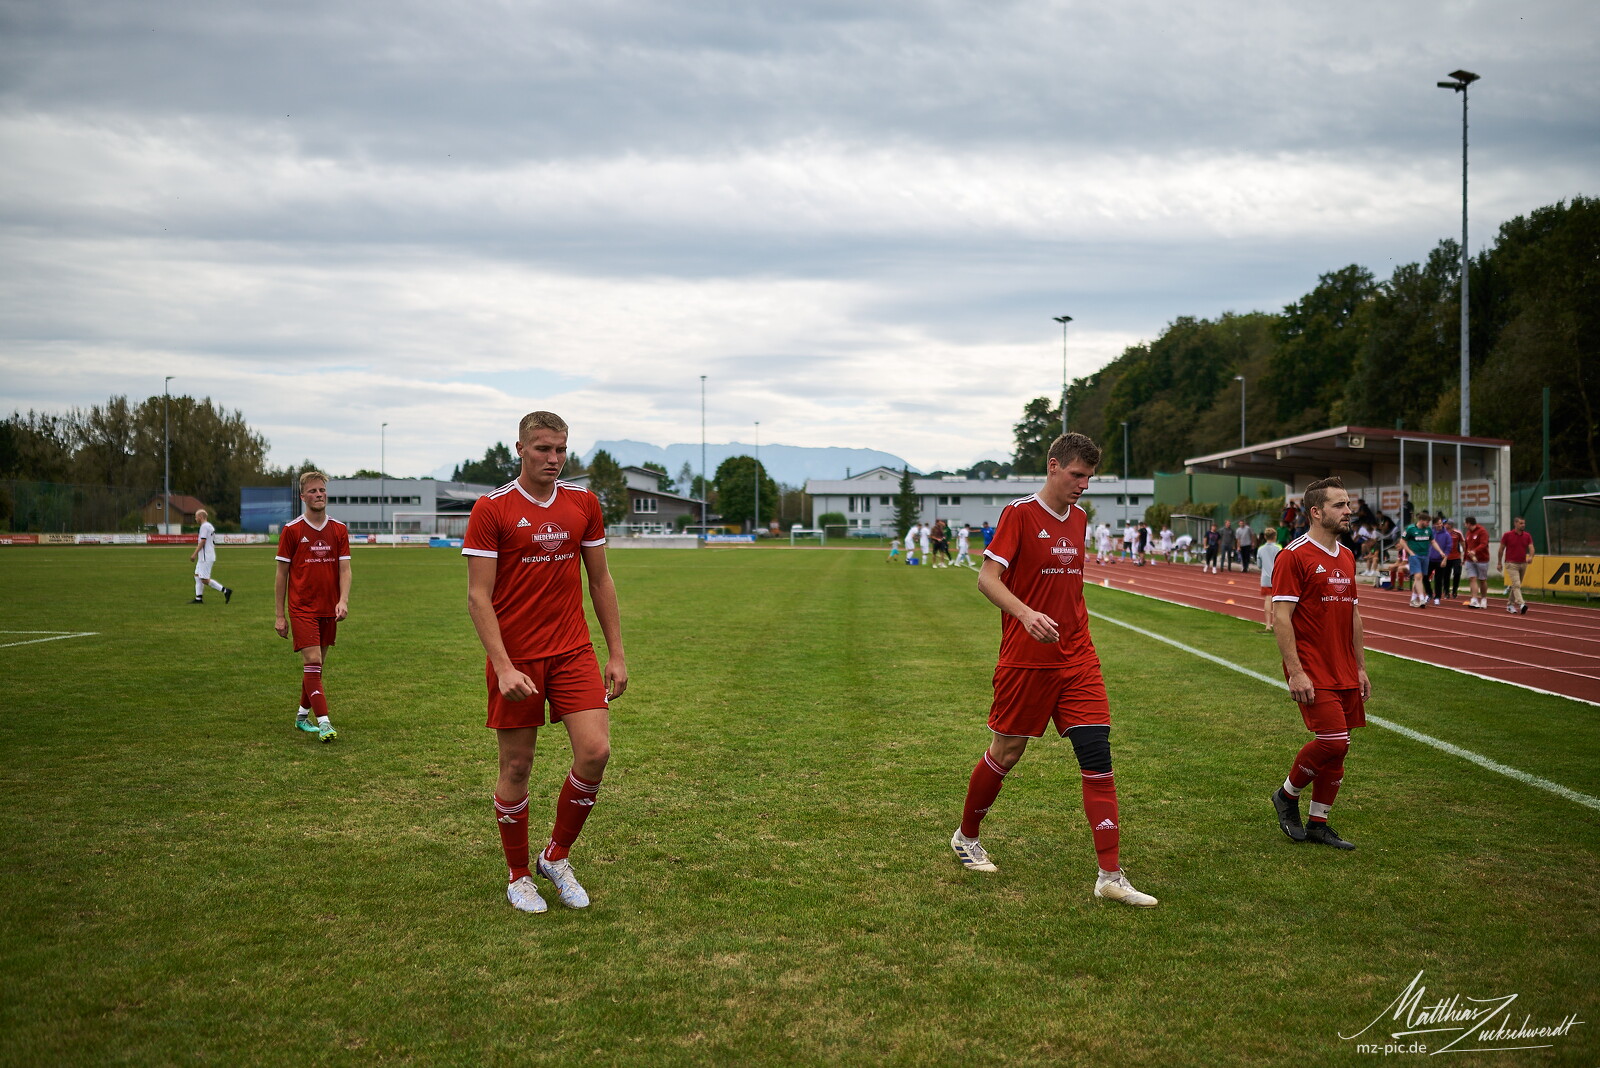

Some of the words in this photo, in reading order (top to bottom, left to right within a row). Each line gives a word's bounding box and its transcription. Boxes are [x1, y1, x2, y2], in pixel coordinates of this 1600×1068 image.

[1413, 487, 1442, 502] ERDAS
[534, 532, 568, 541] NIEDERMEIER
[1575, 563, 1594, 574] MAX
[1597, 564, 1600, 574] A
[1575, 575, 1591, 586] BAU
